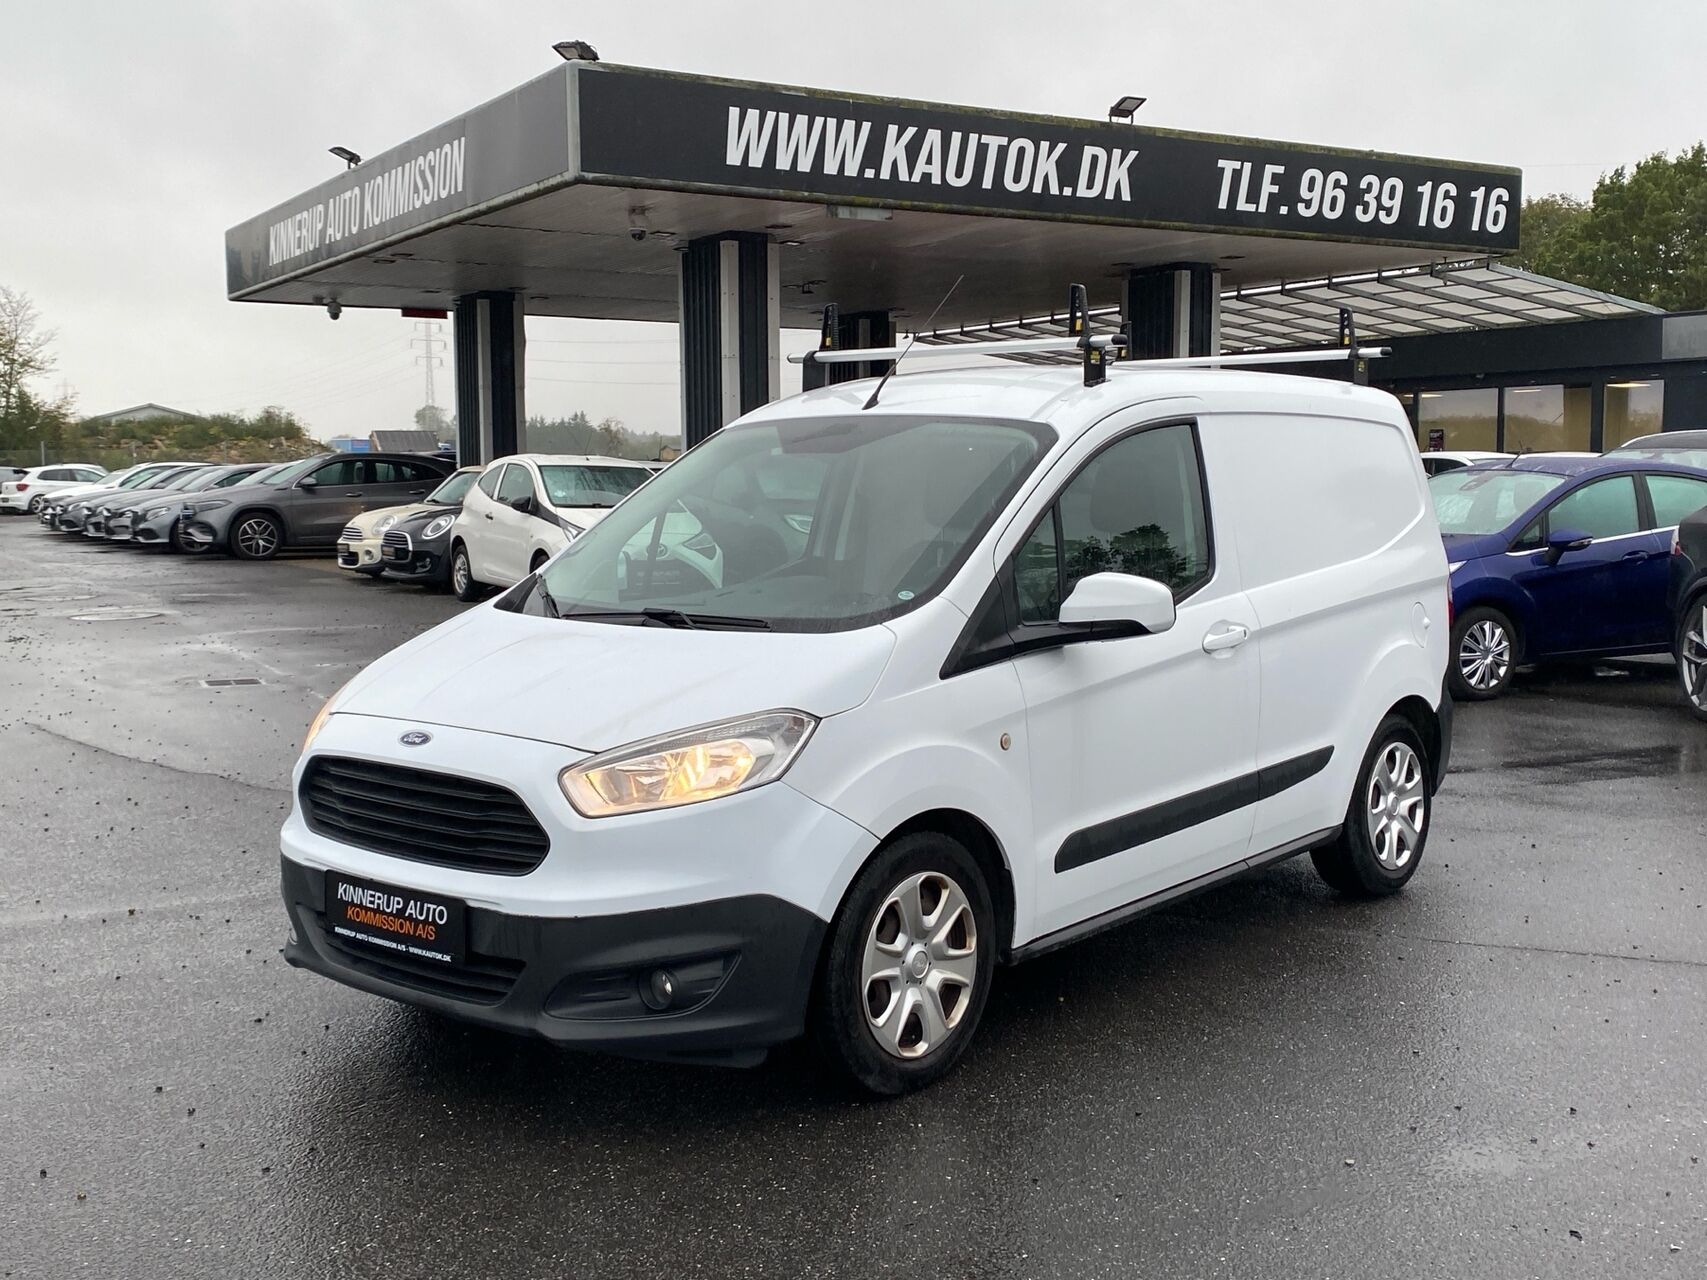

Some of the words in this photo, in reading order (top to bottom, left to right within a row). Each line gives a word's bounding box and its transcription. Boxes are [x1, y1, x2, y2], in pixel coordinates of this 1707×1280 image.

[726, 106, 1139, 201] WWW.KAUTOK.DK
[268, 204, 324, 266] KINNERUP
[325, 186, 360, 244] AUTO
[363, 137, 466, 230] KOMMISSION
[1217, 159, 1288, 215] TLF.
[1297, 168, 1348, 220] 96
[1355, 174, 1404, 225] 39
[1417, 180, 1458, 229] 16
[1470, 186, 1510, 234] 16
[337, 882, 403, 914] KINNERUP
[405, 900, 447, 925] AUTO
[347, 906, 414, 936] KOMMISSION
[416, 925, 436, 941] A/S
